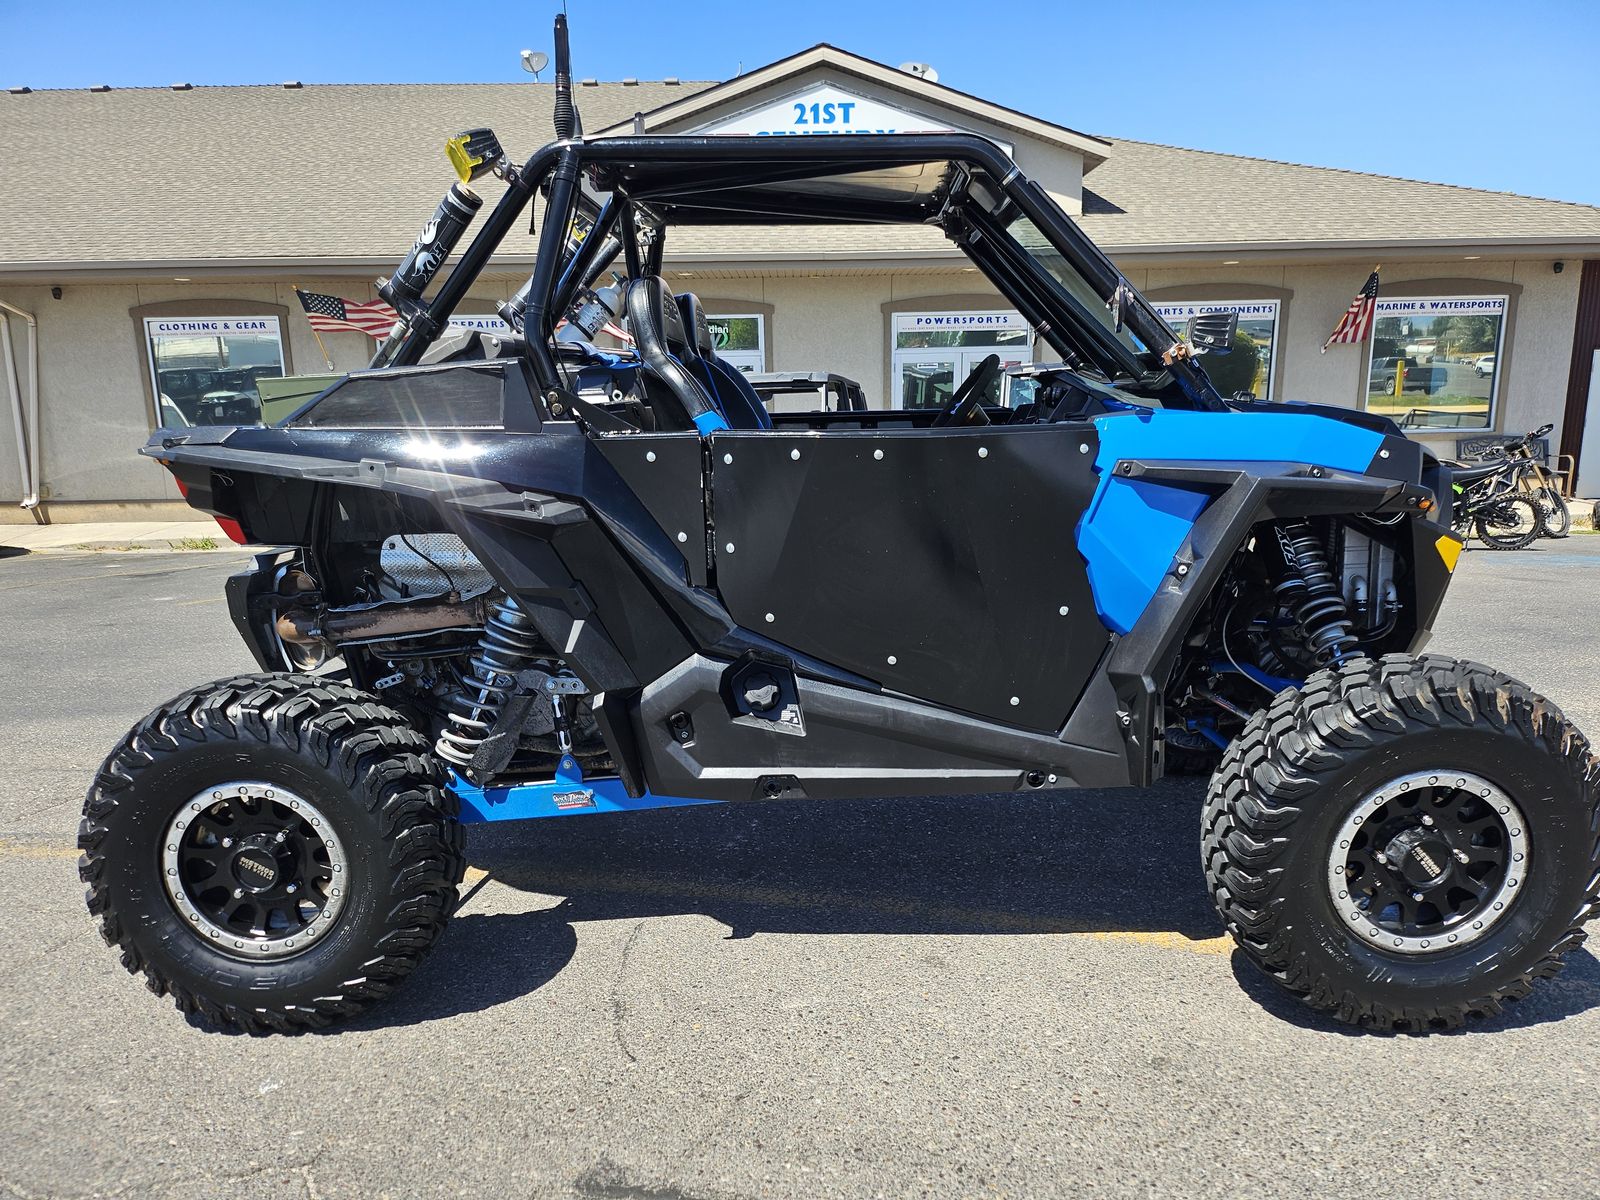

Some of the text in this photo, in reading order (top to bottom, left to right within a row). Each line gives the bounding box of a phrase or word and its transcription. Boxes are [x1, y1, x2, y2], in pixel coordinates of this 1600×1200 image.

[793, 102, 856, 125] 21ST
[417, 241, 449, 284] FOX
[1376, 300, 1503, 311] MARINE & WATERSPORTS
[1156, 307, 1183, 315] ARTS
[1187, 307, 1194, 315] &
[916, 316, 1008, 325] POWERSPORTS
[159, 321, 267, 331] CLOTHING & GEAR
